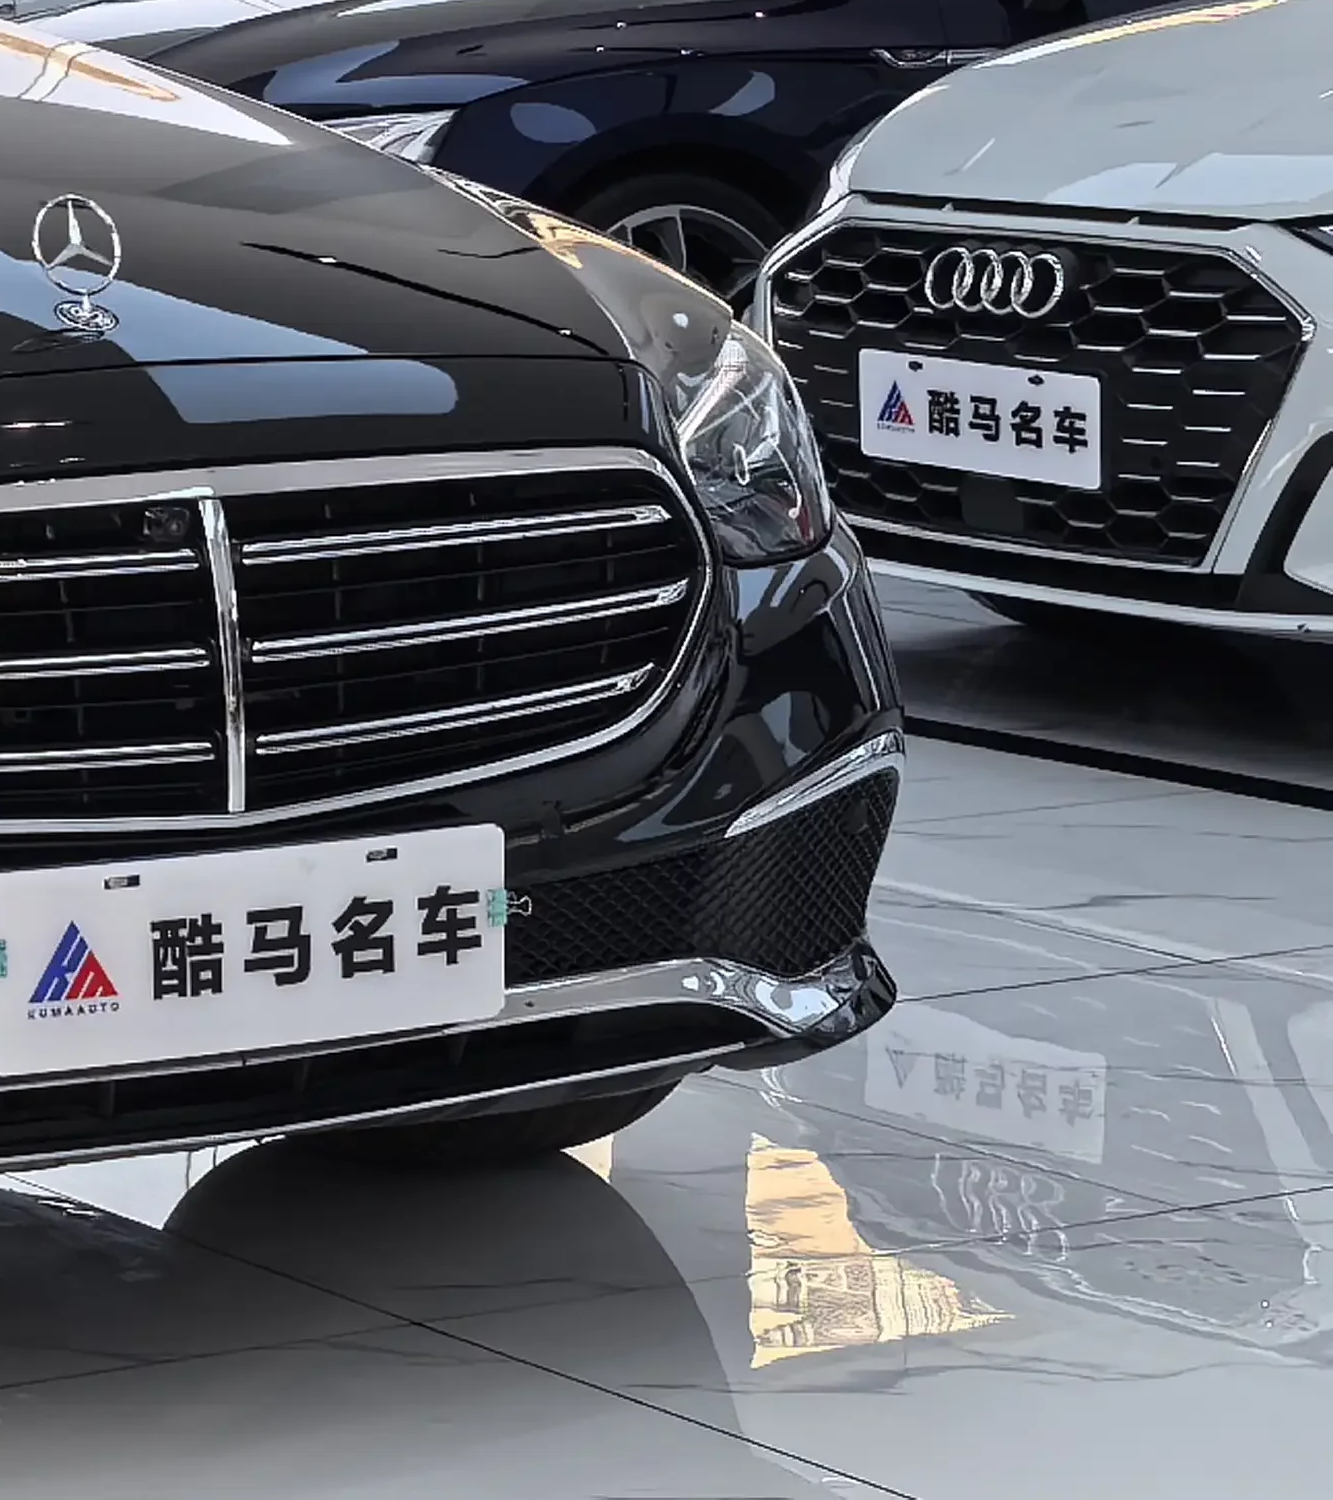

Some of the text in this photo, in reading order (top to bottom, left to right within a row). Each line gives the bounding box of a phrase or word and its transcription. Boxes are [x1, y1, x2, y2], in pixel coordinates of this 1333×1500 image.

[927, 389, 1089, 453] 酷马名车
[150, 885, 482, 1001] 酷马名车
